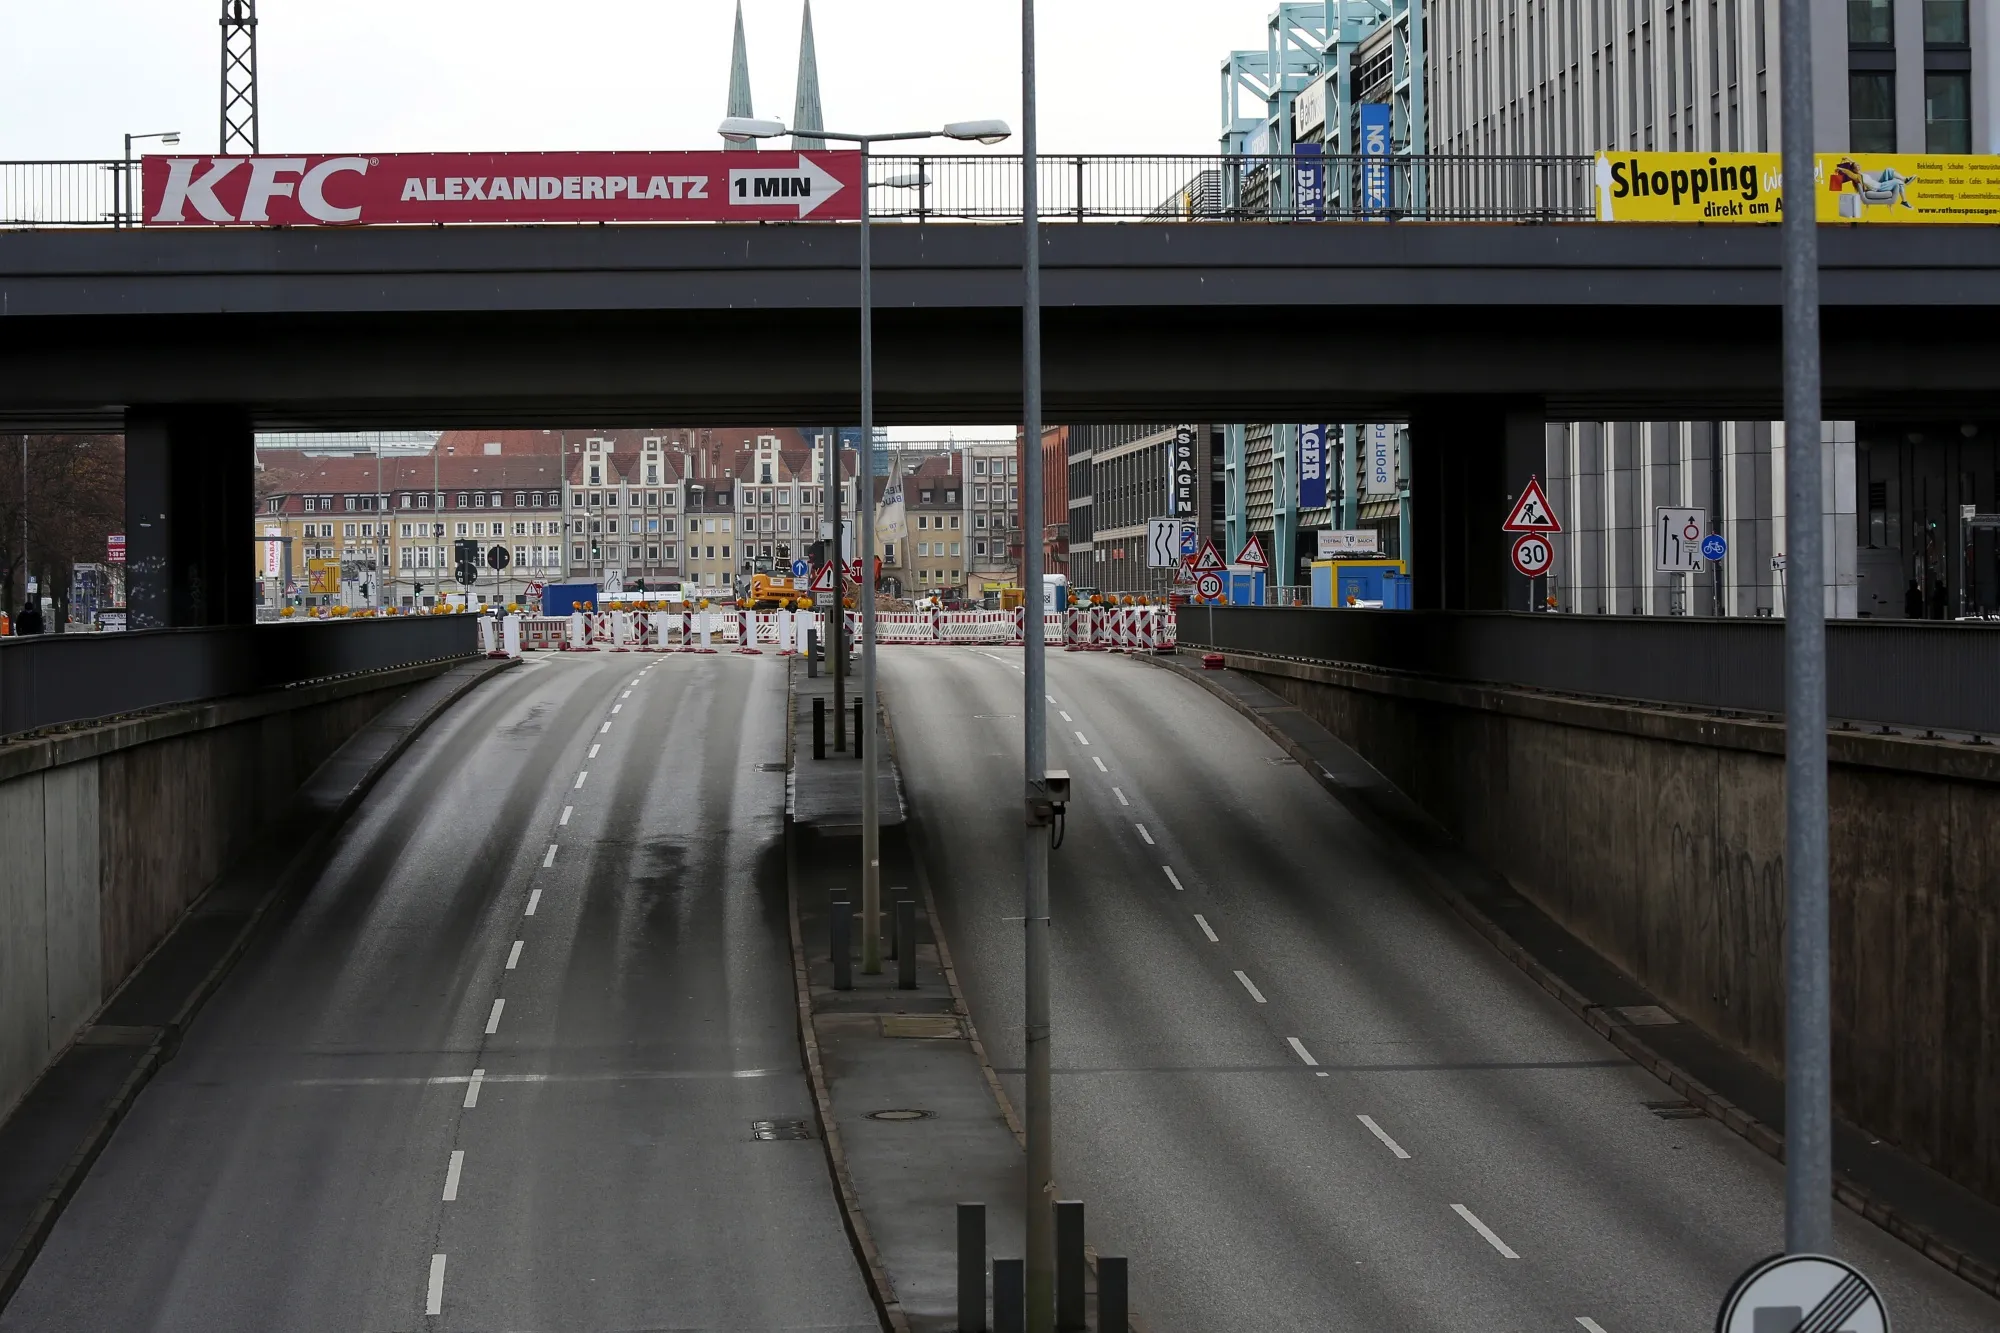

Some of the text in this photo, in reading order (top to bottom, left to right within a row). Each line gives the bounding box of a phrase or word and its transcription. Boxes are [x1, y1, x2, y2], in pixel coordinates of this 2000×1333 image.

[1917, 162, 1943, 171] Bekleidung
[1947, 162, 1964, 170] Schuhe
[151, 157, 369, 222] KFC
[401, 176, 708, 201] ALEXANDERPLATZ
[734, 177, 811, 197] 1 MIN
[1611, 157, 1758, 205] Shopping
[1704, 200, 1743, 217] direkt
[1750, 202, 1769, 214] am
[1375, 442, 1387, 483] SPORT
[1521, 544, 1545, 564] 30
[1202, 580, 1218, 593] 30
